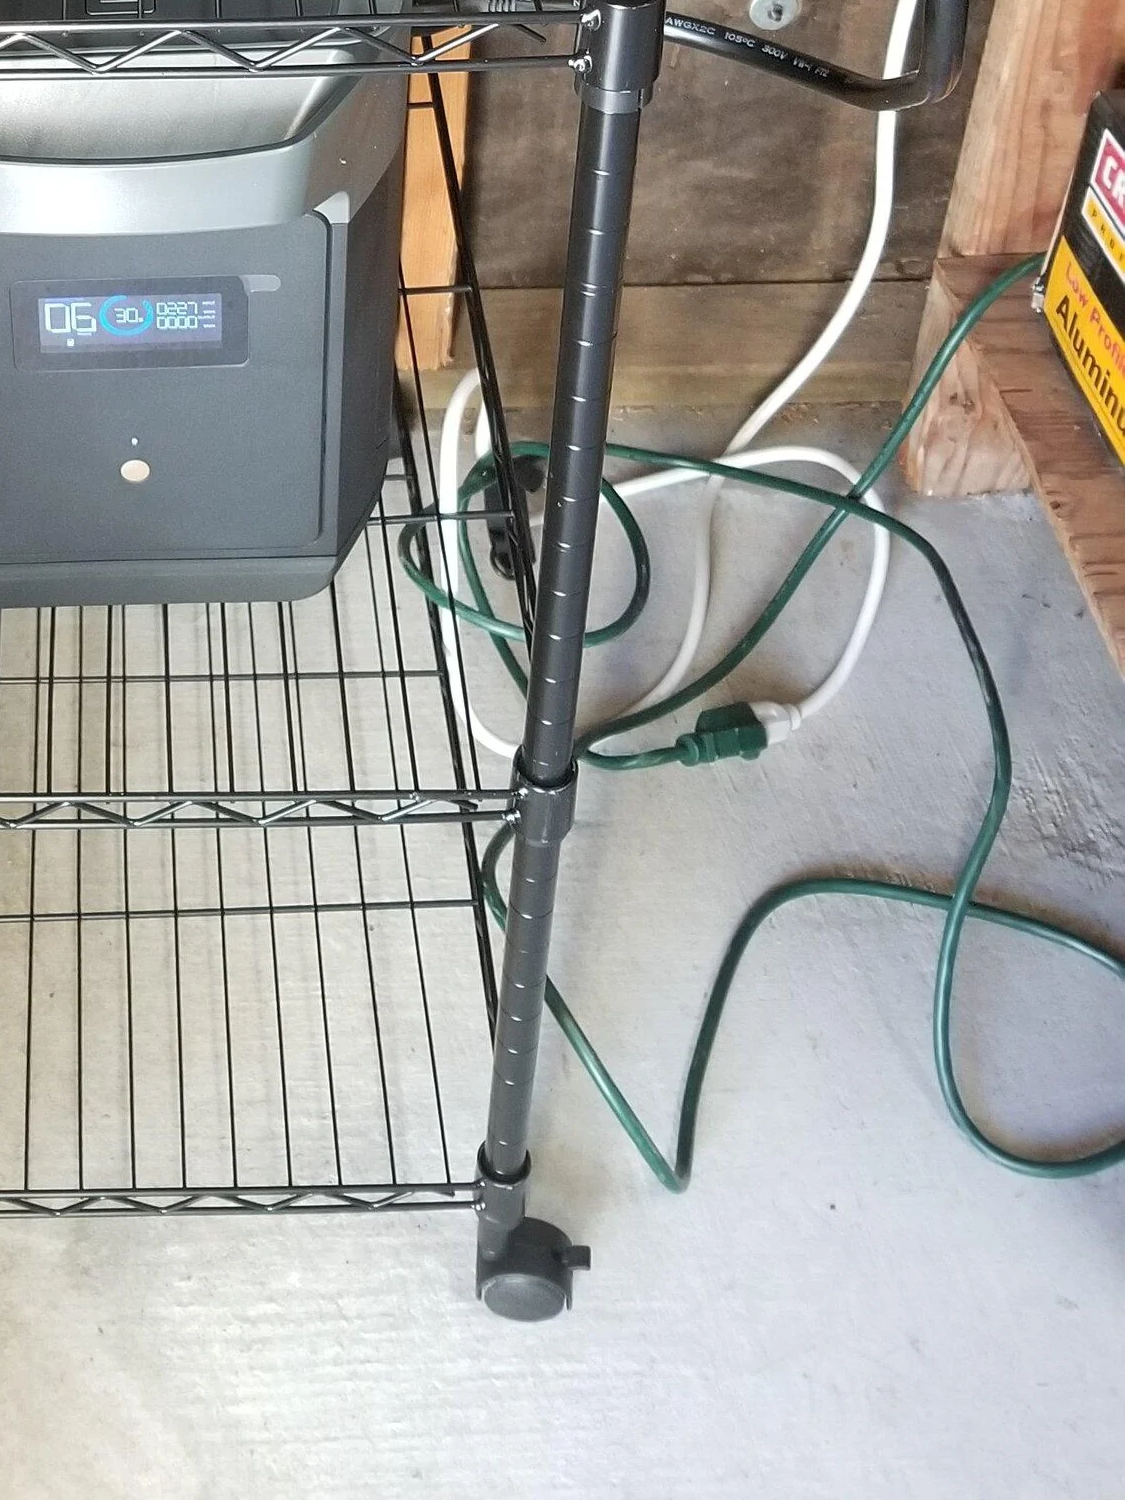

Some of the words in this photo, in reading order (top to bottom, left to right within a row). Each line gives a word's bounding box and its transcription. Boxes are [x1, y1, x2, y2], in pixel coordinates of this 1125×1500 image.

[664, 16, 716, 36] AWGX2C
[1065, 261, 1088, 308] Low
[44, 302, 97, 334] 06
[156, 301, 199, 316] 0227
[156, 315, 199, 330] 0000
